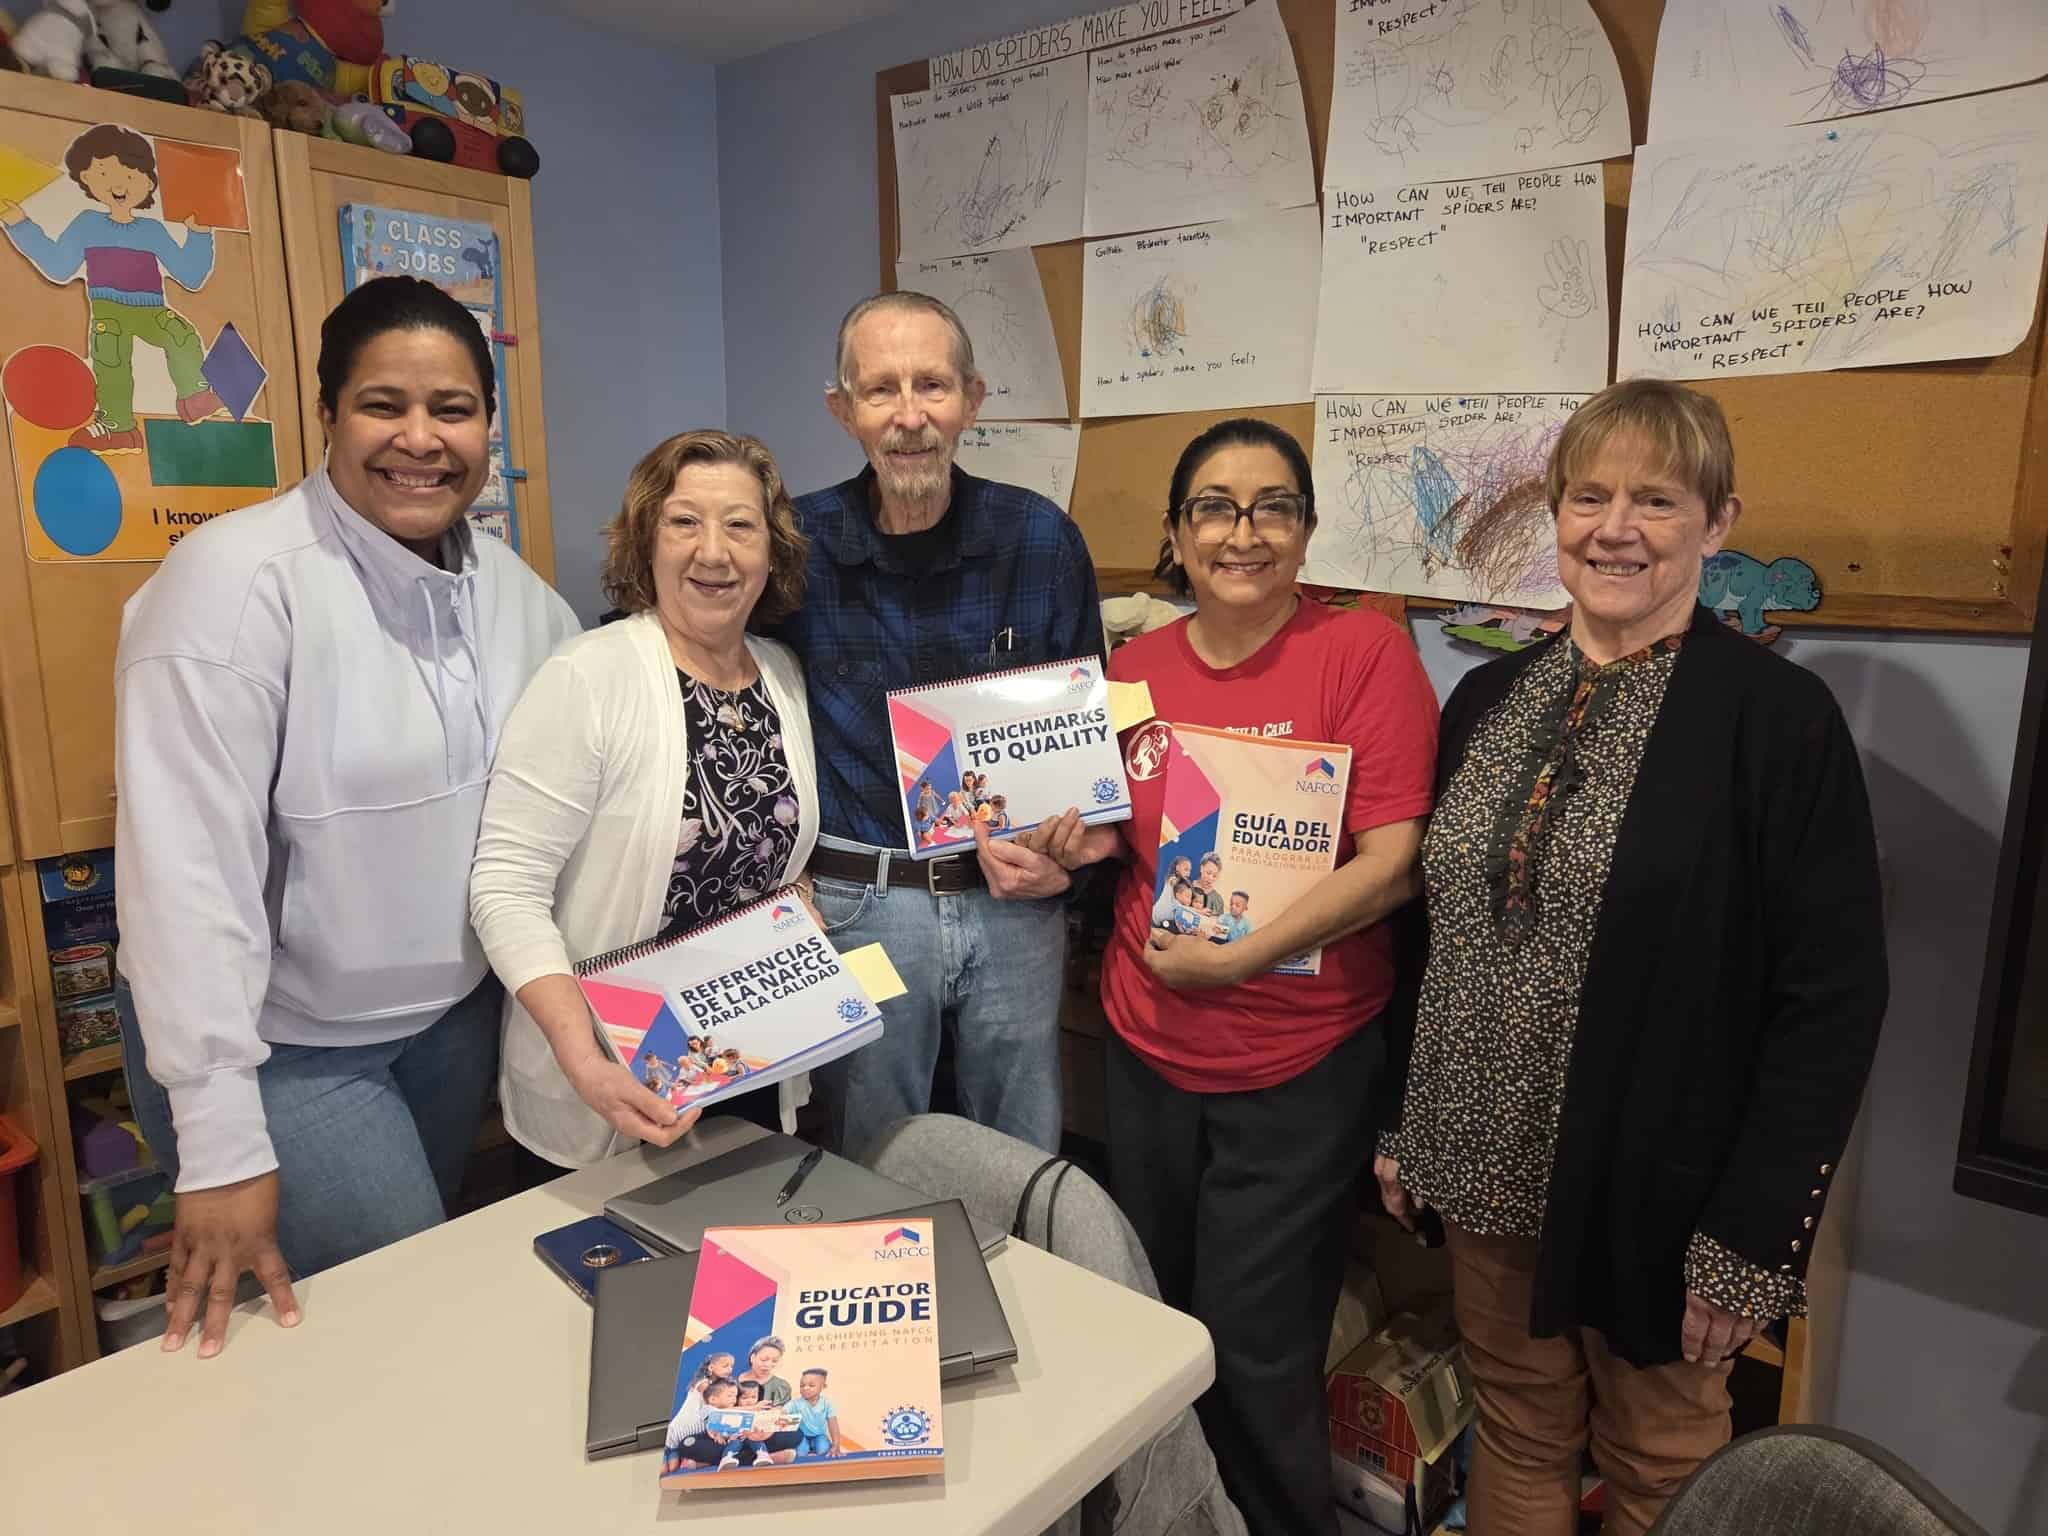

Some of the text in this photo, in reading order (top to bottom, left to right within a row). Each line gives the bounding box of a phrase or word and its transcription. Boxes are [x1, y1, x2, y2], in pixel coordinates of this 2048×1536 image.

[932, 51, 964, 86] HOW
[972, 47, 991, 74] DO
[995, 24, 1072, 67] SPIDERS
[1081, 9, 1127, 46] MAKE
[1141, 0, 1169, 31] YOU
[1337, 191, 1375, 209] HOW
[1397, 188, 1429, 203] CAN
[1518, 174, 1561, 190] PEOPLE
[1574, 171, 1597, 186] HOW
[1331, 208, 1424, 228] IMPORTANT
[1510, 197, 1537, 212] ARE?
[387, 220, 463, 250] CLASS
[399, 250, 457, 275] JOBS
[1638, 321, 1681, 337] HOW
[1700, 312, 1735, 328] CAN
[1752, 307, 1779, 321] WE
[1843, 289, 1910, 308] PEOPLE
[1928, 280, 1973, 298] HOW
[1768, 313, 1857, 334] SPIDERS
[1874, 305, 1926, 322] ARE?
[1206, 360, 1223, 371] you
[1231, 352, 1256, 366] feel?
[1326, 399, 1362, 419] HOW
[1371, 398, 1407, 418] CAN
[1497, 395, 1548, 409] PEOPLE
[1559, 397, 1581, 411] HO
[1329, 411, 1522, 442] IMPORTANT SPIDER ARE?
[153, 508, 159, 525] I
[966, 707, 1106, 747] BENCHMARKS
[1263, 720, 1293, 736] CARE
[968, 725, 1108, 767] TO QUALITY
[1296, 780, 1341, 795] NAFCC
[1234, 812, 1332, 838] GUÍA DEL
[1232, 830, 1330, 853] EDUCADOR
[680, 936, 823, 1005] REFERENCIAS
[689, 950, 833, 1019] DE LA NAFCC
[698, 964, 840, 1030] PARA LA CALIDAD
[874, 1247, 930, 1260] NAFCC
[799, 1282, 931, 1304] EDUCATOR
[795, 1298, 931, 1329] GUIDE
[795, 1327, 934, 1344] TO ACHIEVING NAFCC
[795, 1336, 933, 1352] ACCREDITATION
